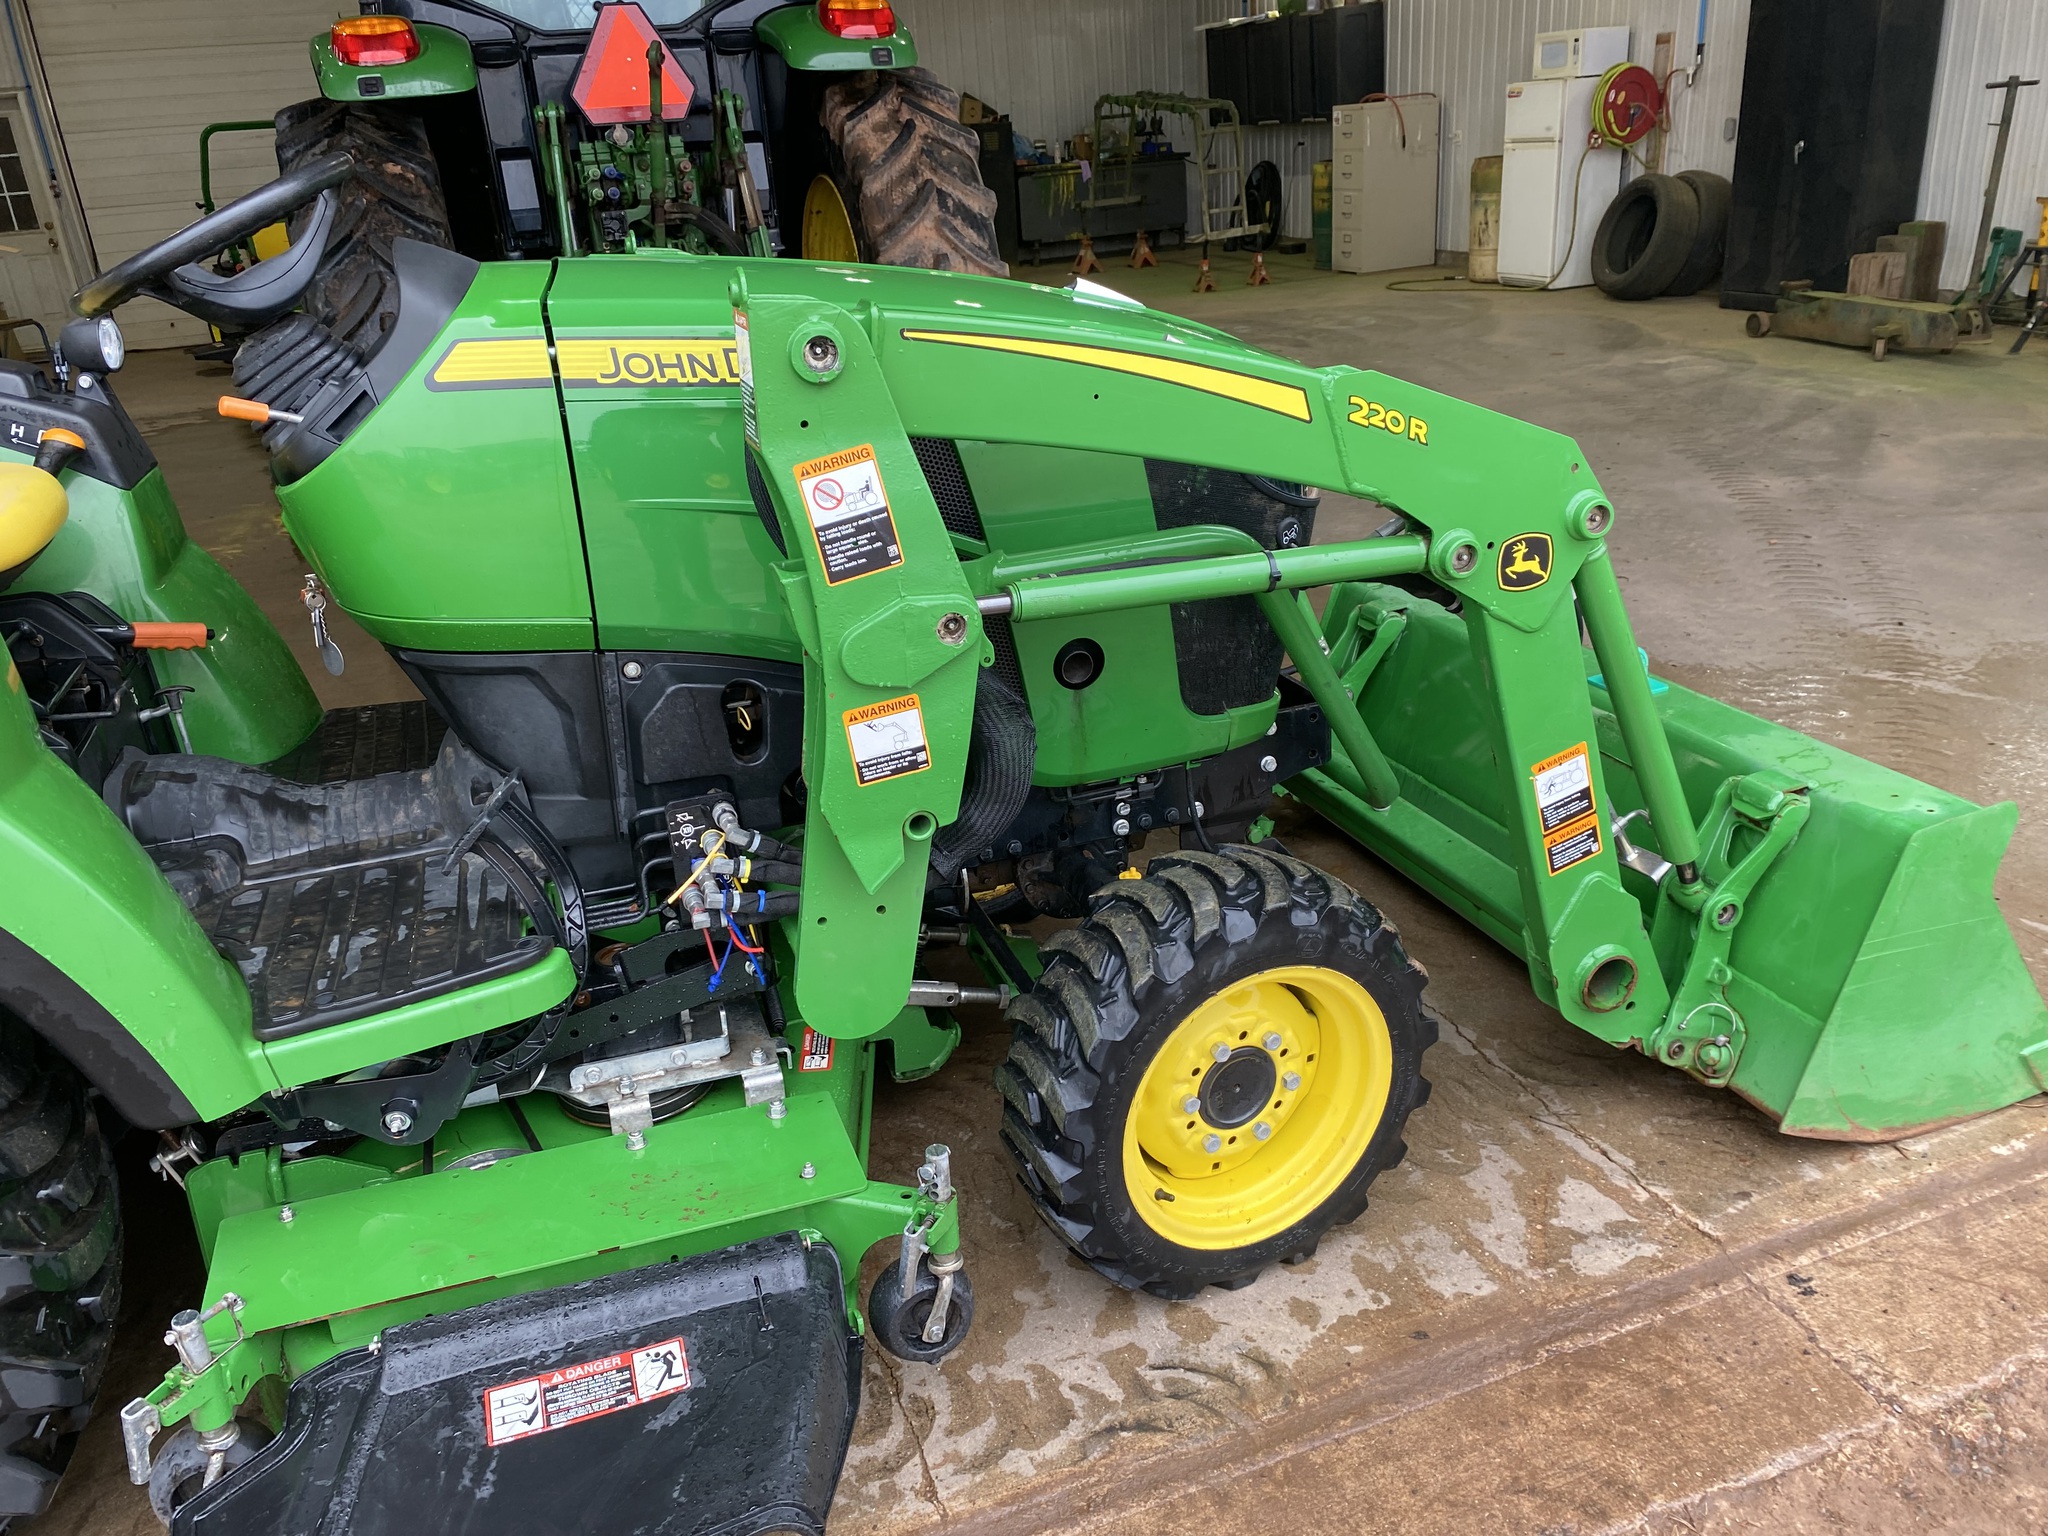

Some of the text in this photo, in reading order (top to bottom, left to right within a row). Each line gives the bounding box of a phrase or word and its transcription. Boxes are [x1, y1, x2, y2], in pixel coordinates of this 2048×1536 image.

[599, 347, 719, 380] JOHN
[10, 423, 24, 438] H
[810, 447, 871, 474] WARNING
[858, 697, 916, 720] WARNING
[1546, 747, 1580, 768] WARNING
[1559, 820, 1592, 840] WARNING
[566, 1357, 621, 1379] DANGER
